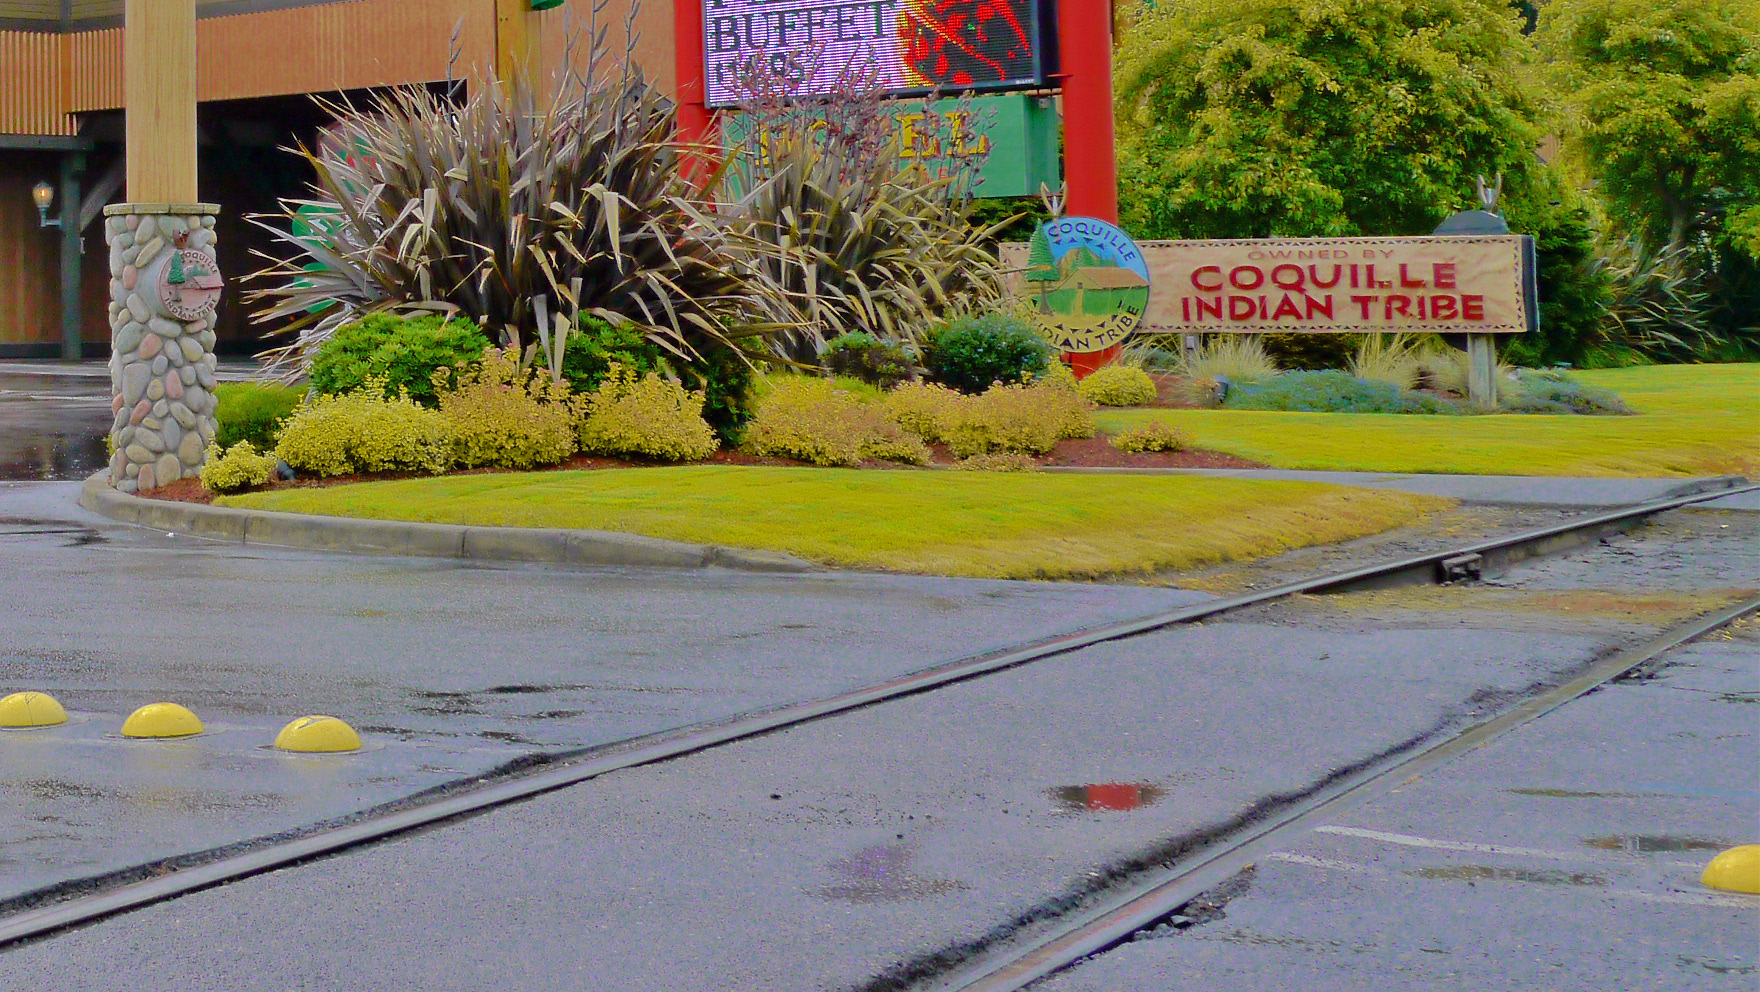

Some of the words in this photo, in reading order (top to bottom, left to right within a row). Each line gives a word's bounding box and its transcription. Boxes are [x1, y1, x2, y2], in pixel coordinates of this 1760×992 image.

[709, 0, 897, 53] BUFFET
[1047, 222, 1136, 262] COQUILLE
[1248, 249, 1349, 259] OWNED
[1363, 249, 1395, 259] BY
[1190, 263, 1457, 295] COQUILLE
[1181, 292, 1334, 322] INDIAN
[1350, 293, 1485, 321] TRIBE
[1038, 321, 1090, 350] DIAN
[1095, 305, 1139, 346] TRIBE
